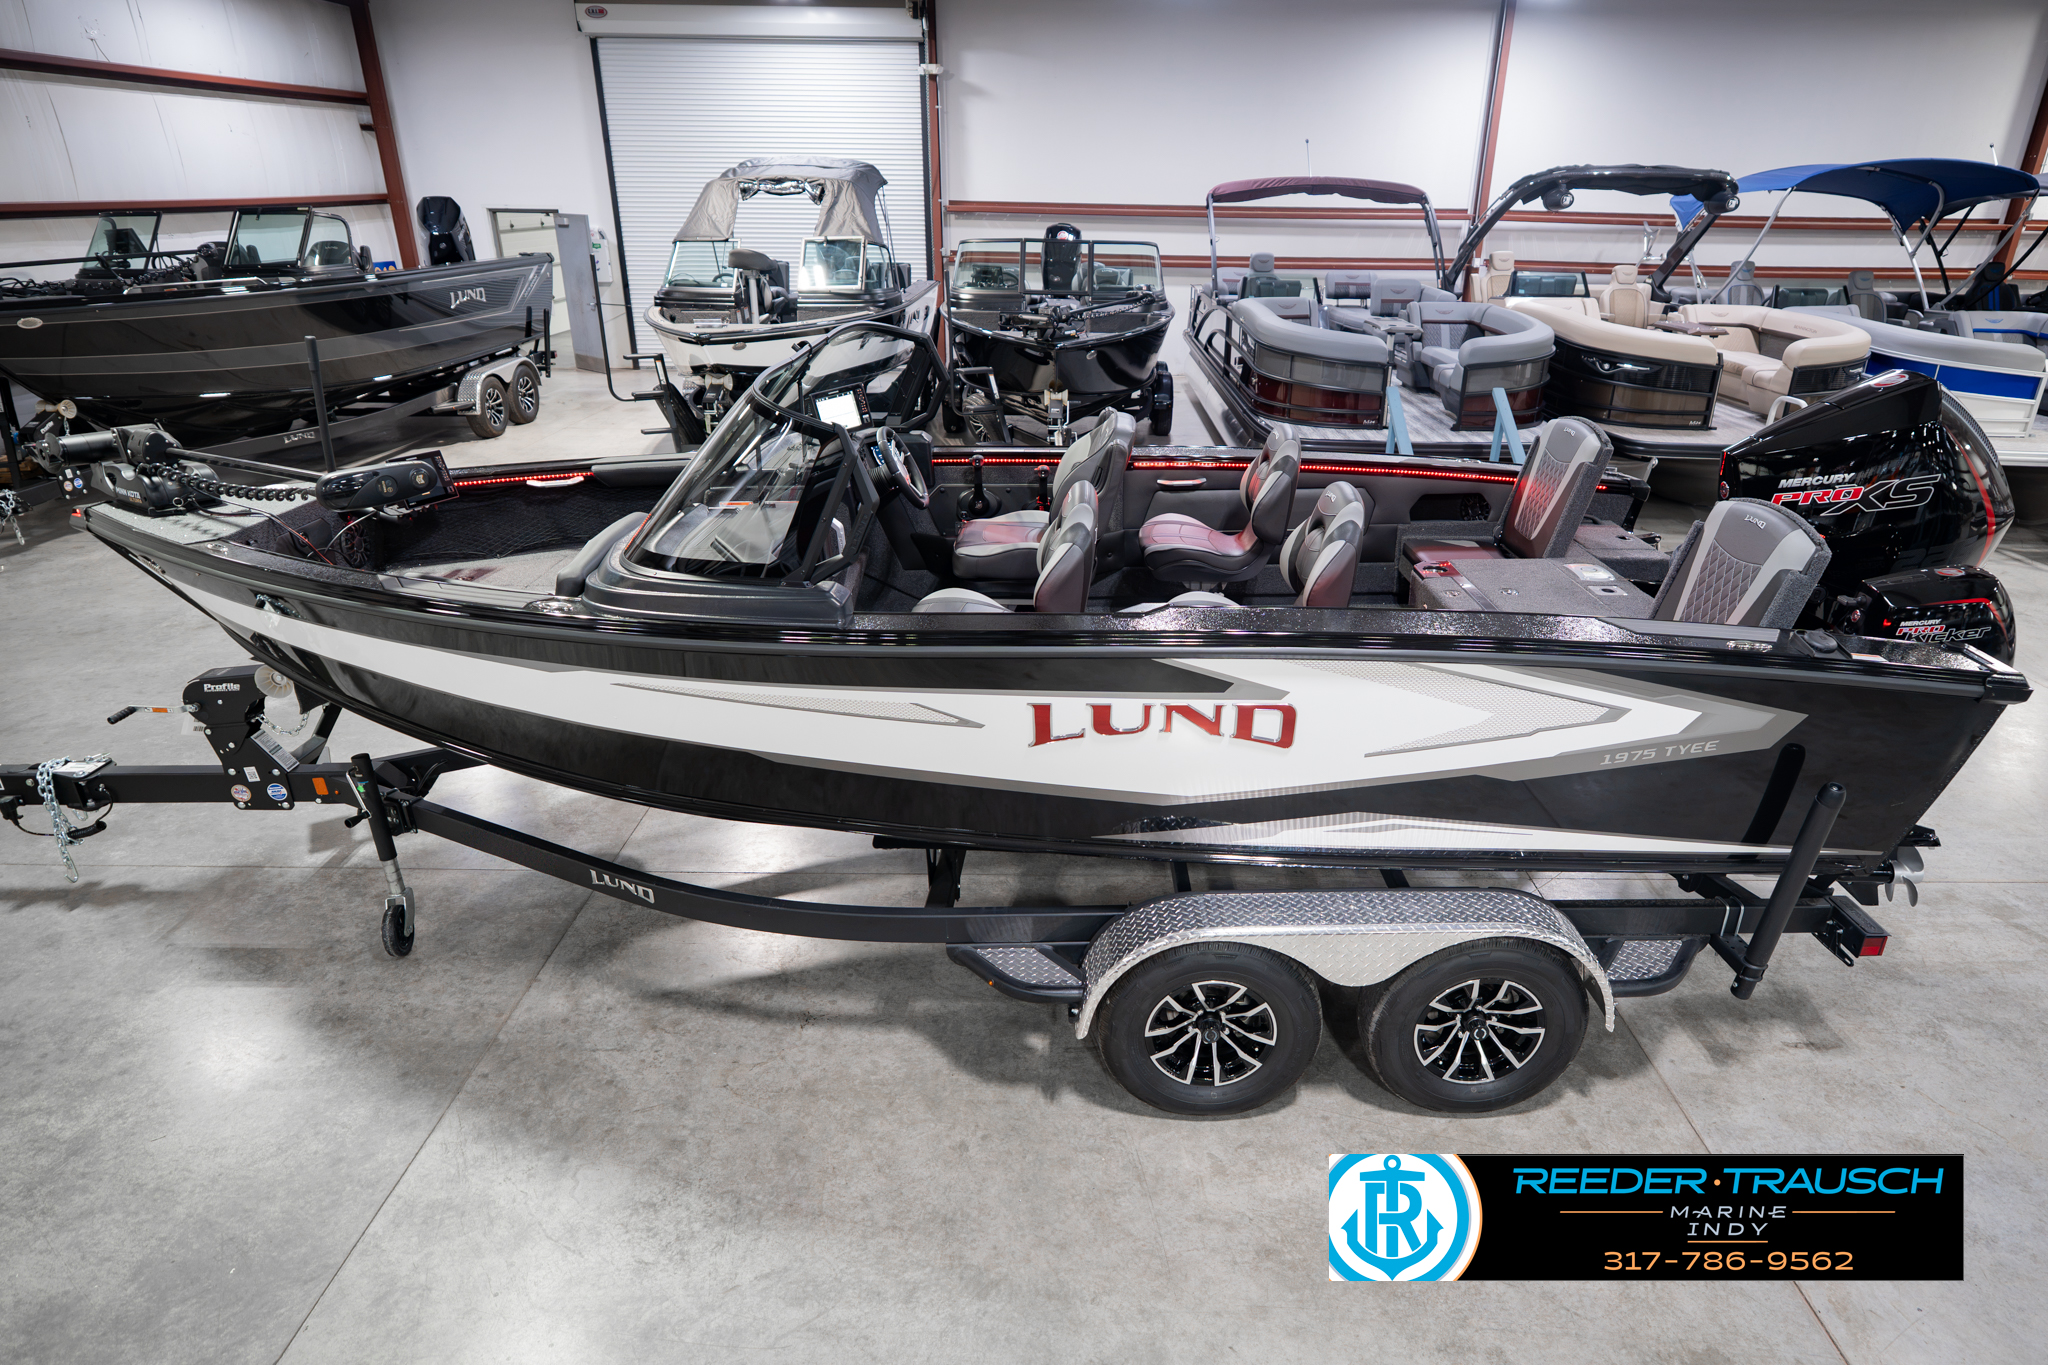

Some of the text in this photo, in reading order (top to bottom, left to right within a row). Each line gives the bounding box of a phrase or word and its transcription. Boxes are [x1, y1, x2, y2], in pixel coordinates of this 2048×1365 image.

[449, 287, 487, 309] LUND
[1778, 473, 1856, 489] MERCURY
[1770, 473, 1942, 517] PRO XS
[1743, 514, 1767, 530] LUND
[1895, 624, 1946, 636] PRO
[1899, 618, 1942, 627] MERCURY
[203, 682, 241, 691] Profile
[1026, 702, 1298, 750] LUND
[1600, 740, 1720, 766] 1975 TYEE
[589, 868, 655, 904] LUND
